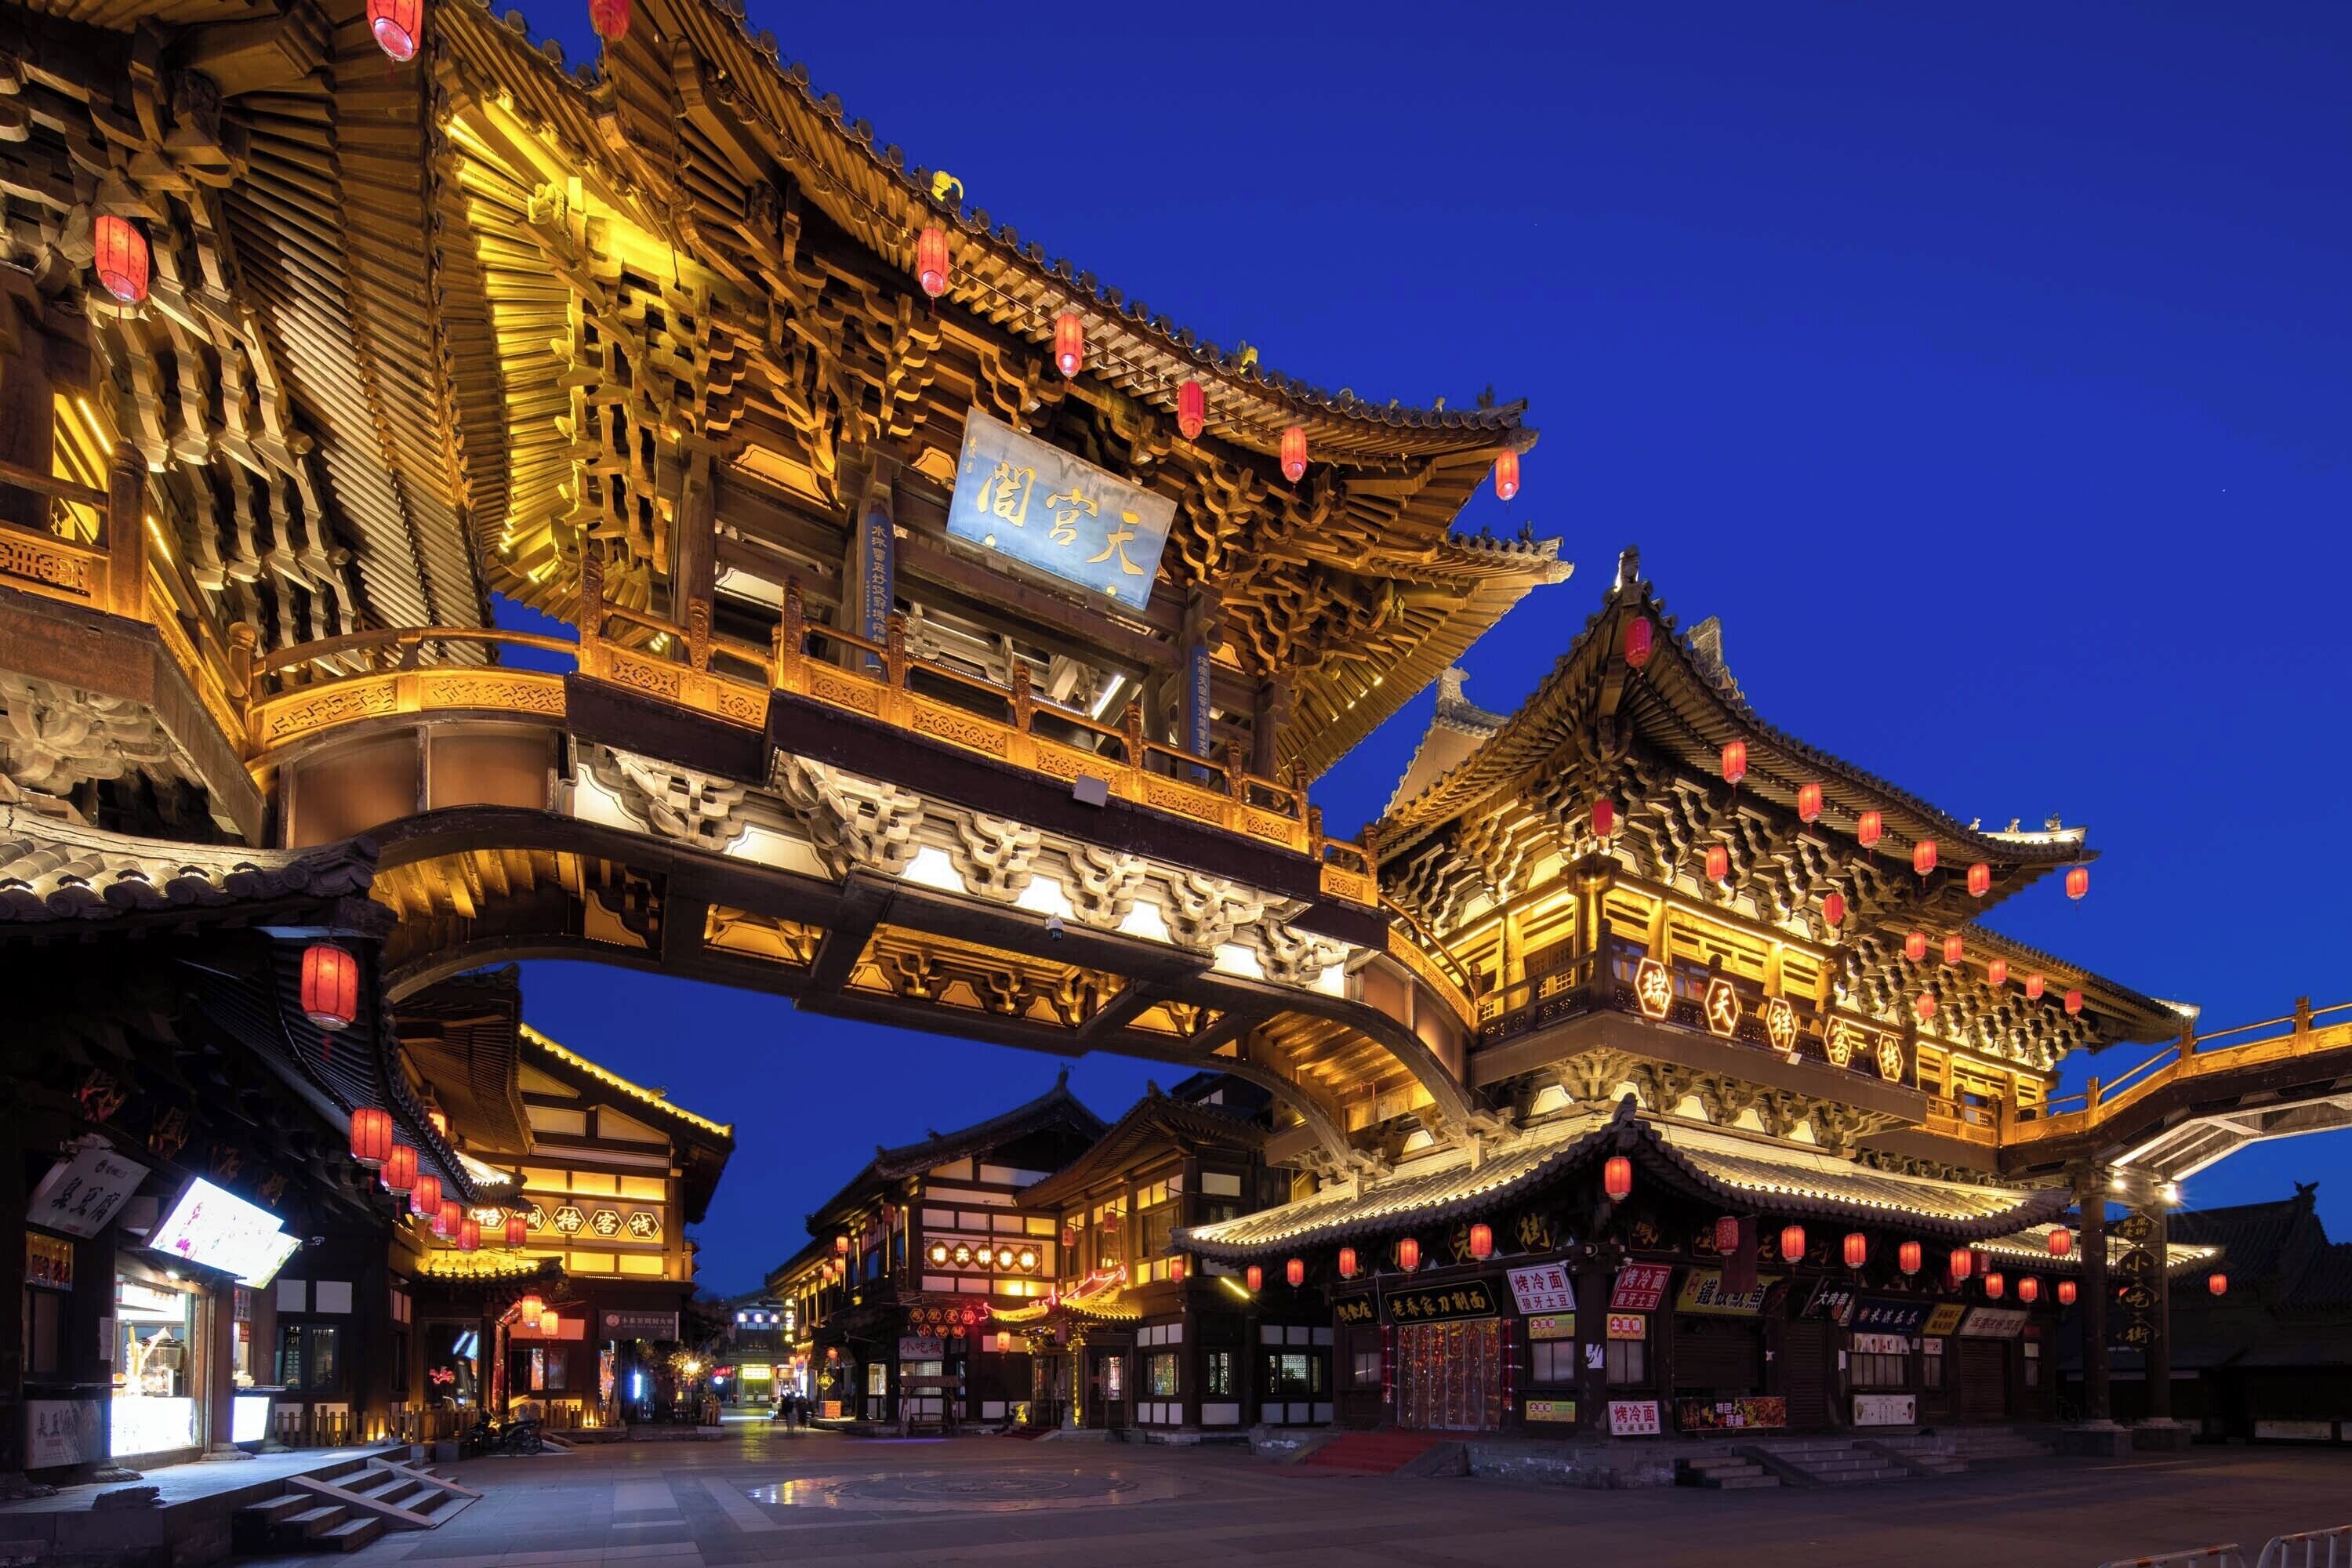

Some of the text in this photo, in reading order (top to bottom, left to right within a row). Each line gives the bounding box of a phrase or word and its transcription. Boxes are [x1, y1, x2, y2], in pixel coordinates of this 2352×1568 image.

[1515, 1270, 1564, 1294] 烤冷面
[1622, 1267, 1668, 1291] 烤冷面
[1522, 1294, 1570, 1311] 狼牙土豆
[1615, 1291, 1660, 1308] 狼牙土豆
[1816, 1290, 1850, 1306] 大肉串
[902, 1341, 942, 1355] 小吃城
[1613, 1404, 1656, 1425] 烤冷面
